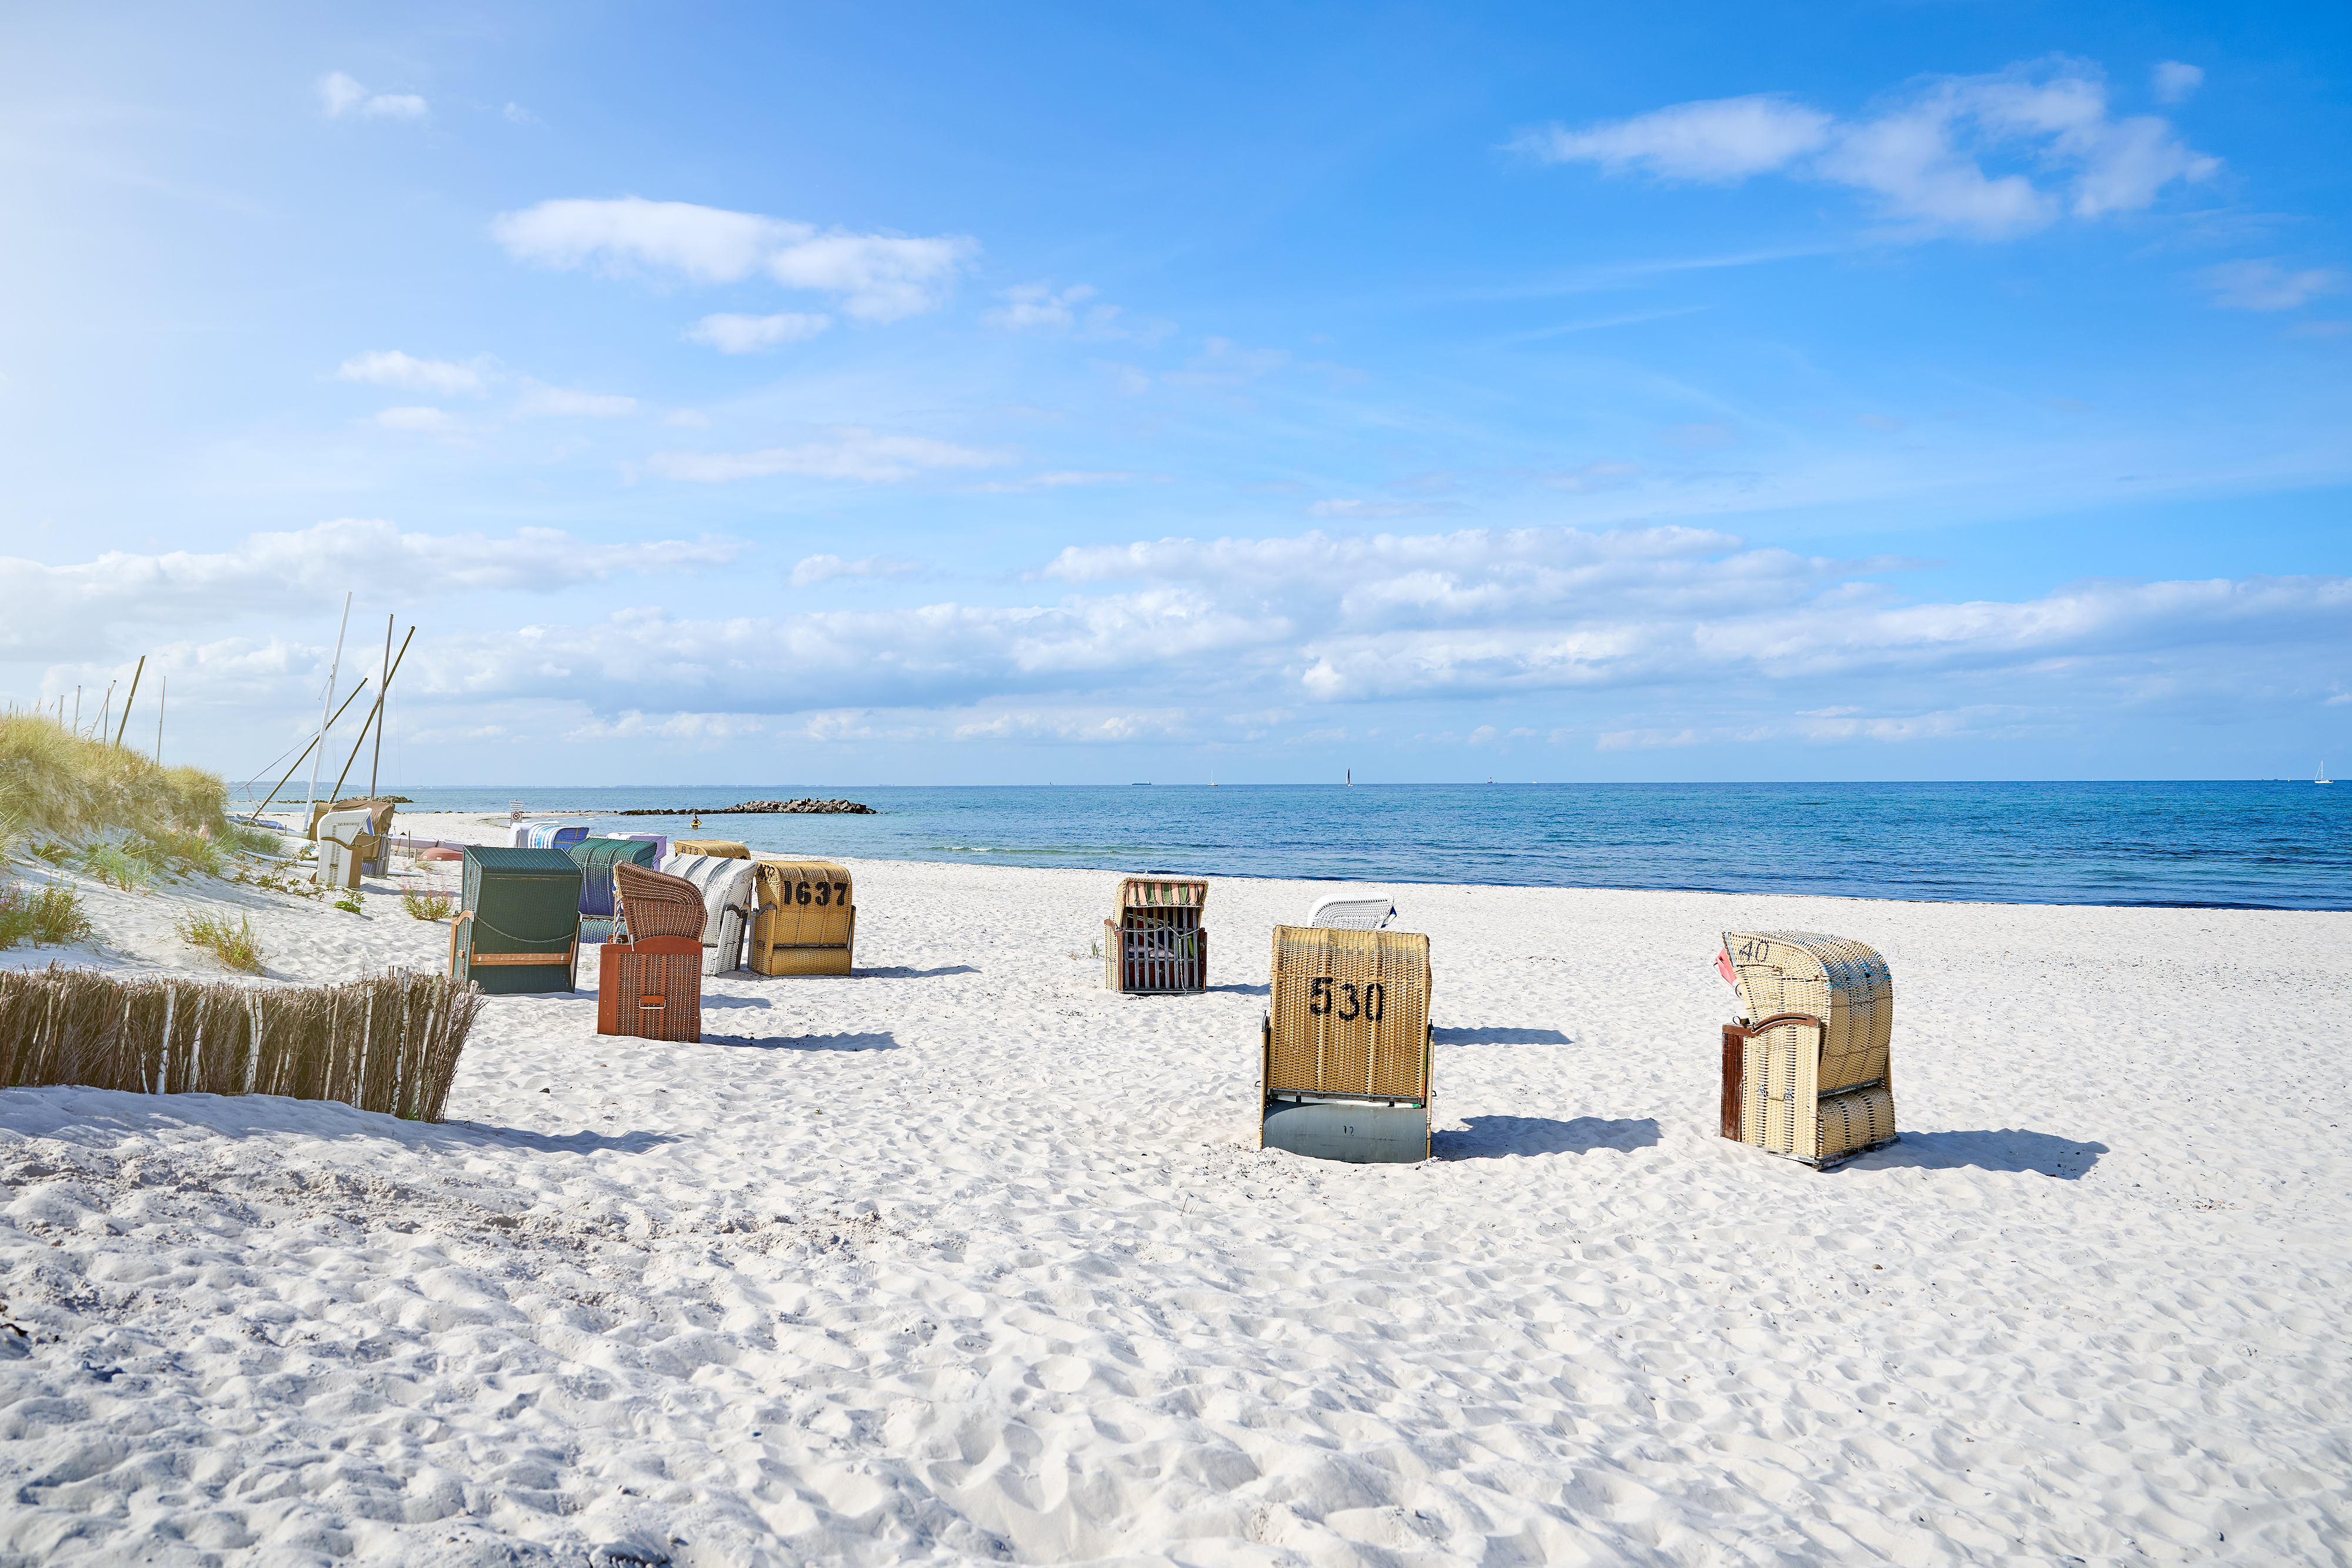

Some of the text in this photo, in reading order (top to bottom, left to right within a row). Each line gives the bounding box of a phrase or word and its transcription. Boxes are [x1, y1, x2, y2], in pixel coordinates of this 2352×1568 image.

[784, 881, 848, 906] 1637
[1739, 941, 1769, 962] 40
[1310, 977, 1385, 1021] 530
